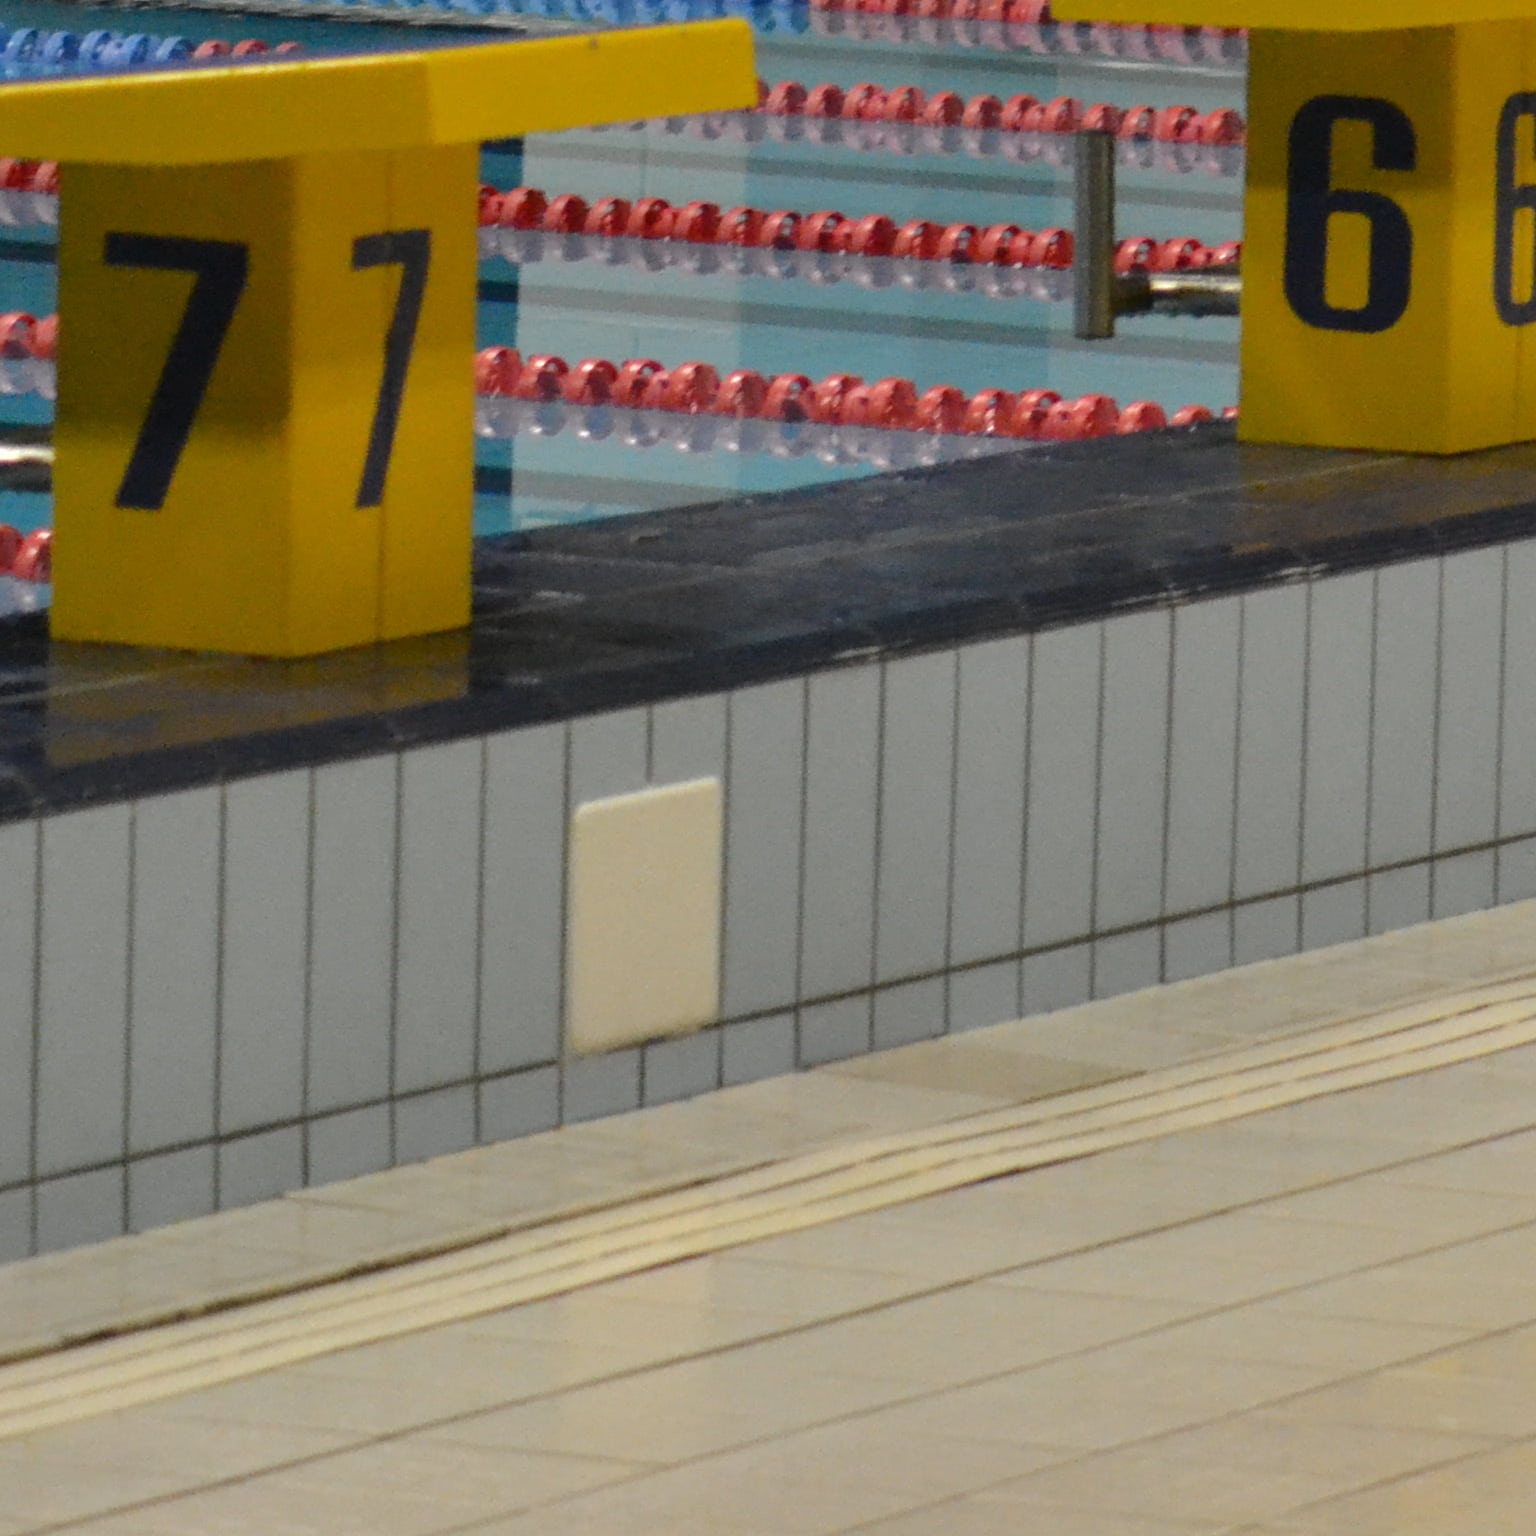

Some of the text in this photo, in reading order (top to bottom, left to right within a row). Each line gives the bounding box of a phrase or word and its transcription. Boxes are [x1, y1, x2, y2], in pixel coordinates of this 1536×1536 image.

[1284, 94, 1417, 332] 6
[103, 231, 250, 511] 7
[352, 229, 431, 508] 7
